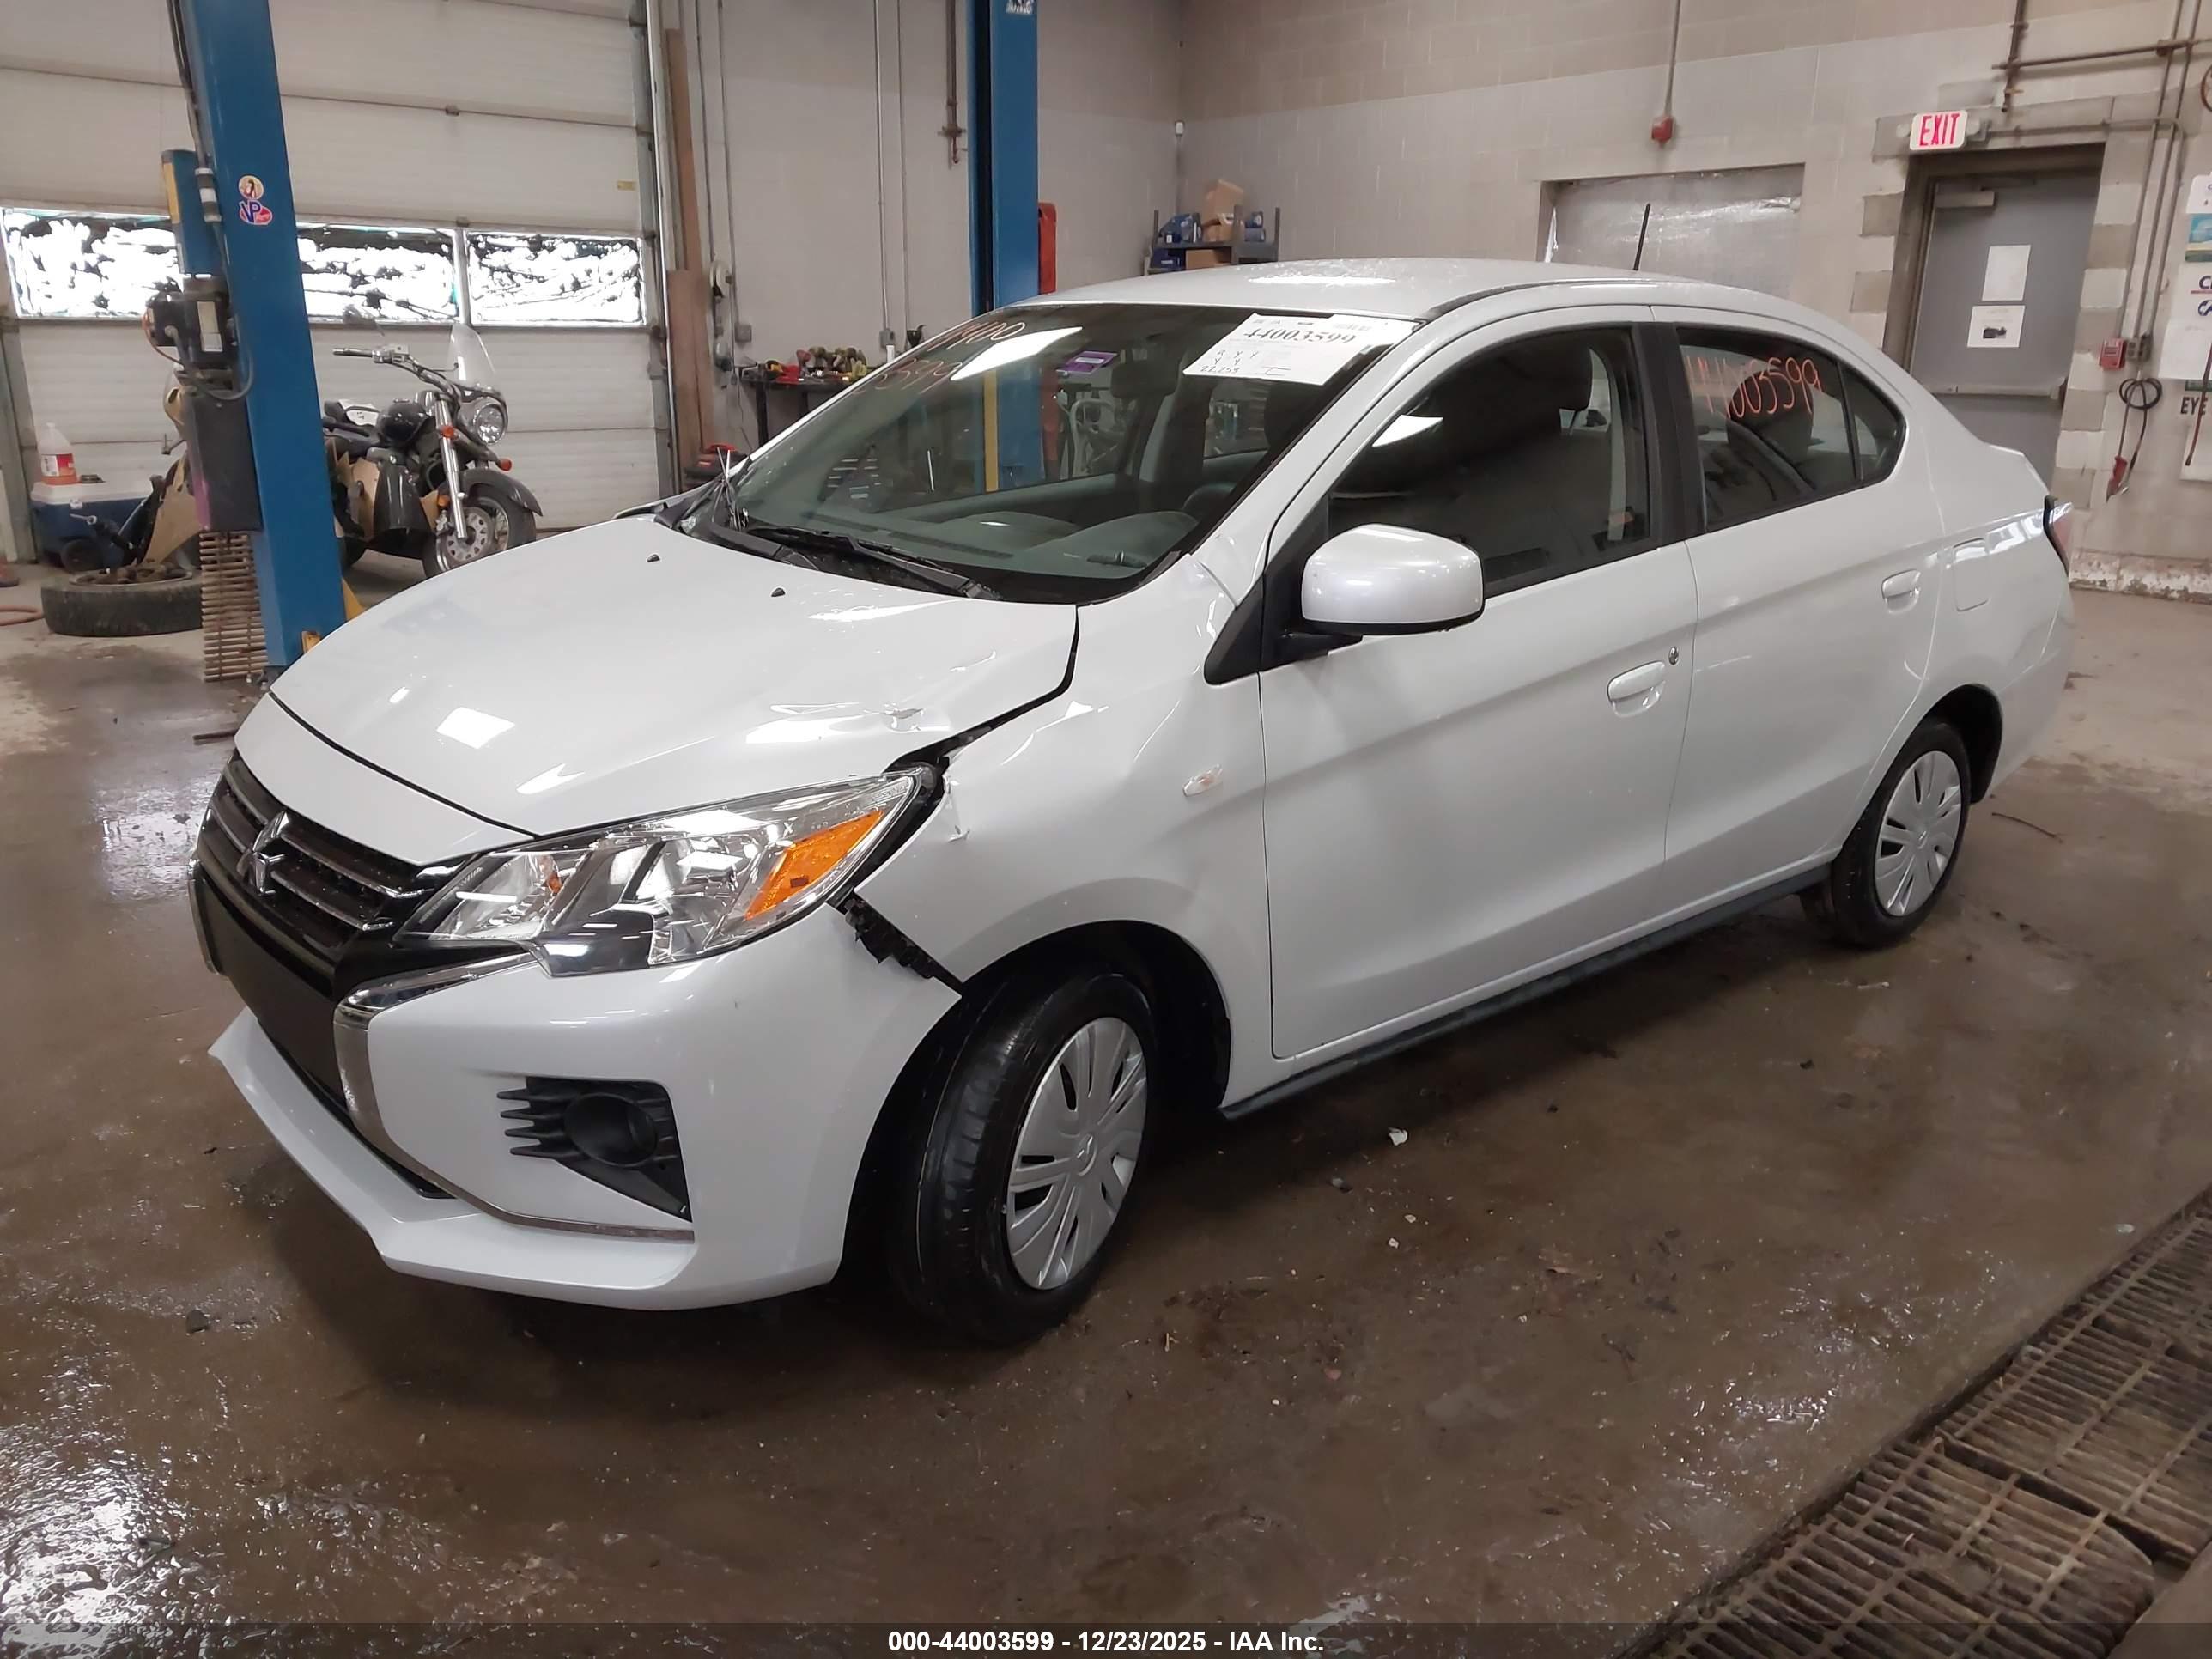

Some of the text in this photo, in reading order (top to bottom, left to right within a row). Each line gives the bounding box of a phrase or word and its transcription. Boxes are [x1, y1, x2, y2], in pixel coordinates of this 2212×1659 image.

[1919, 113, 1960, 146] EXIT
[240, 200, 261, 223] VP
[1243, 328, 1357, 343] 44003599
[1686, 355, 1823, 419] 44003599
